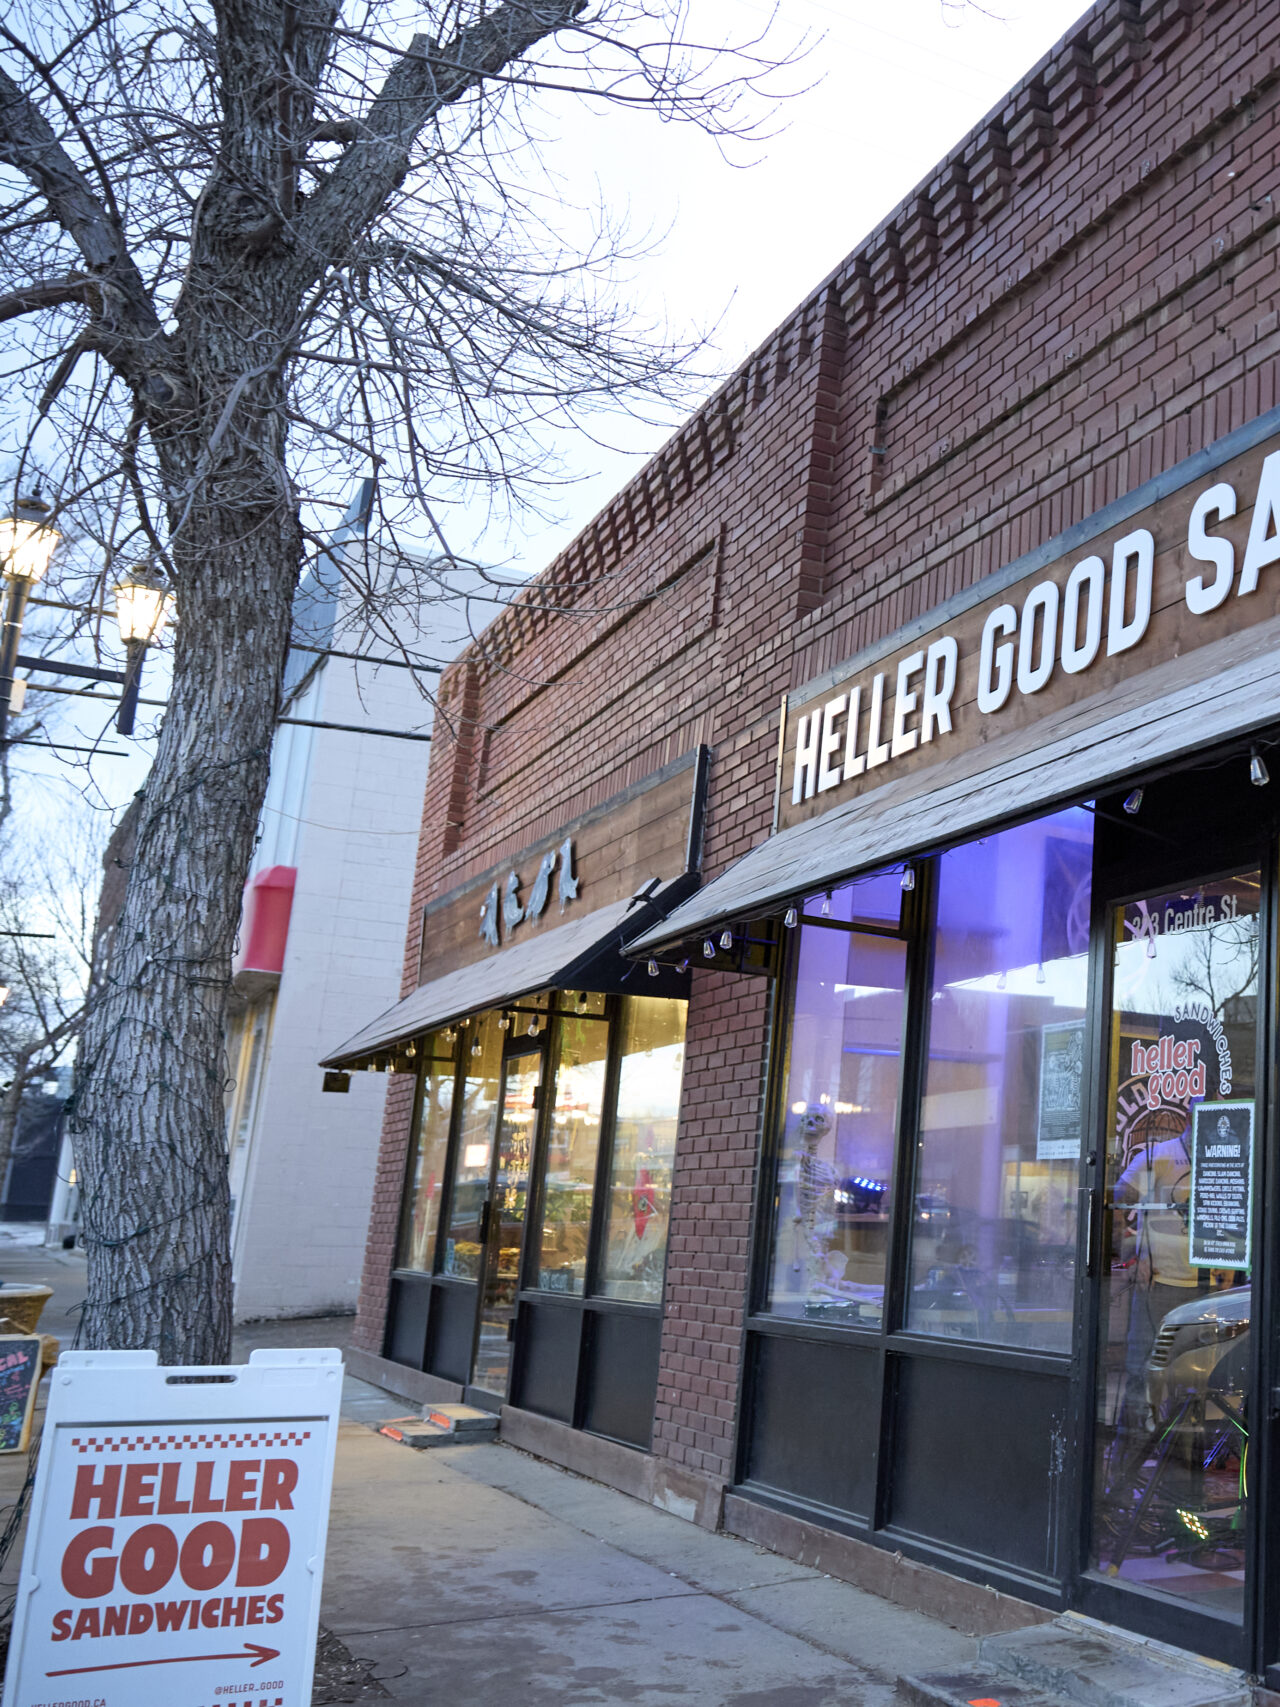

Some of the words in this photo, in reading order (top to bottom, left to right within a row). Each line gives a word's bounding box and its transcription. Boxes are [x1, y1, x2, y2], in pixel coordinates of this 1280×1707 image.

[792, 636, 958, 805] HELLER
[977, 528, 1154, 714] GOOD
[1164, 904, 1215, 933] Centre
[1220, 895, 1244, 921] St.
[1131, 1034, 1200, 1076] heller
[1174, 1002, 1232, 1095] SANDWICHES
[1147, 1060, 1206, 1110] good
[1205, 1144, 1241, 1157] WARNING!
[69, 1459, 298, 1520] HELLER
[61, 1517, 290, 1599] GOOD
[51, 1594, 284, 1641] SANDWICHES
[214, 1680, 284, 1696] @HELLER_GOOD
